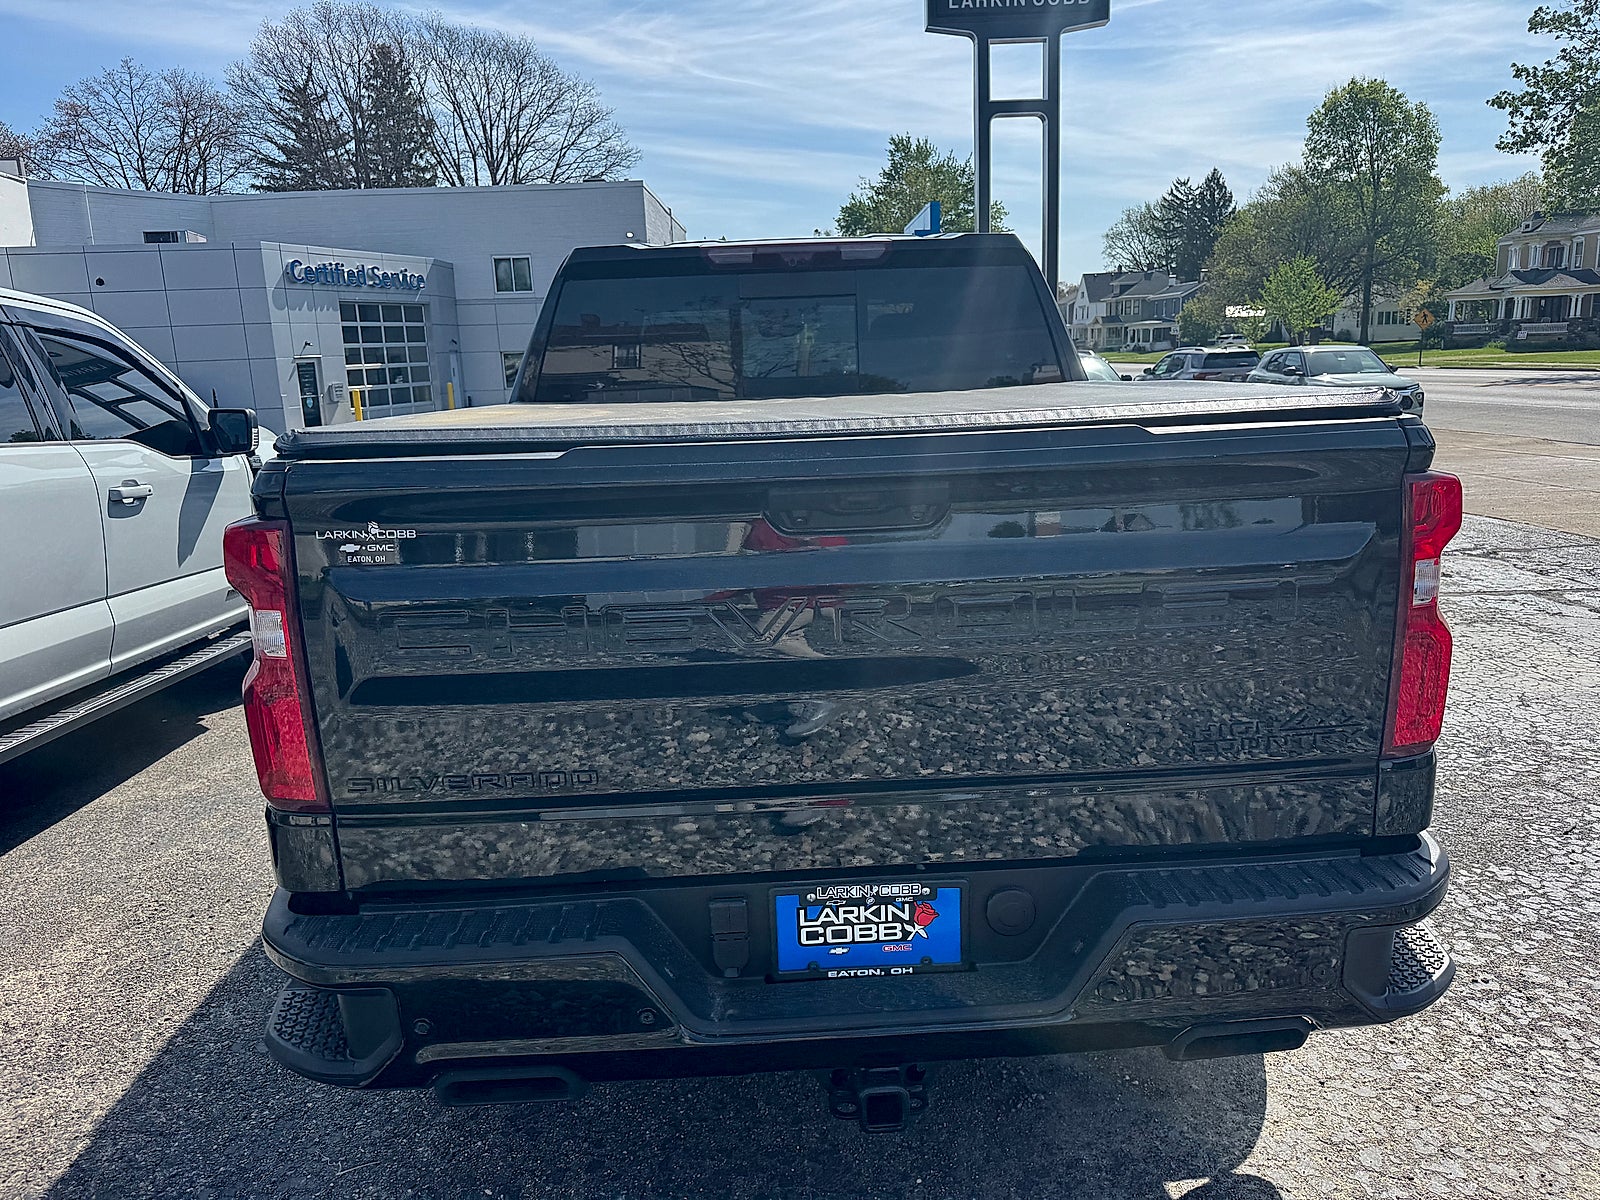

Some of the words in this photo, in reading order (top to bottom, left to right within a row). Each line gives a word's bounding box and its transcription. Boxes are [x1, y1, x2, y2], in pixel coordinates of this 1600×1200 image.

[289, 259, 367, 287] Certified
[370, 265, 426, 290] Service
[315, 529, 367, 540] LARKIN
[376, 529, 417, 539] COBB
[366, 544, 395, 552] GMC
[347, 555, 374, 564] EATON,
[375, 555, 386, 563] OH
[347, 769, 600, 794] SILVERADO
[816, 885, 870, 900] LARKIN
[878, 883, 923, 897] COBB
[799, 903, 910, 927] LARKIN
[799, 922, 903, 945] COBB
[882, 943, 913, 953] GMC
[827, 968, 885, 978] EATON,
[890, 966, 914, 975] OH
